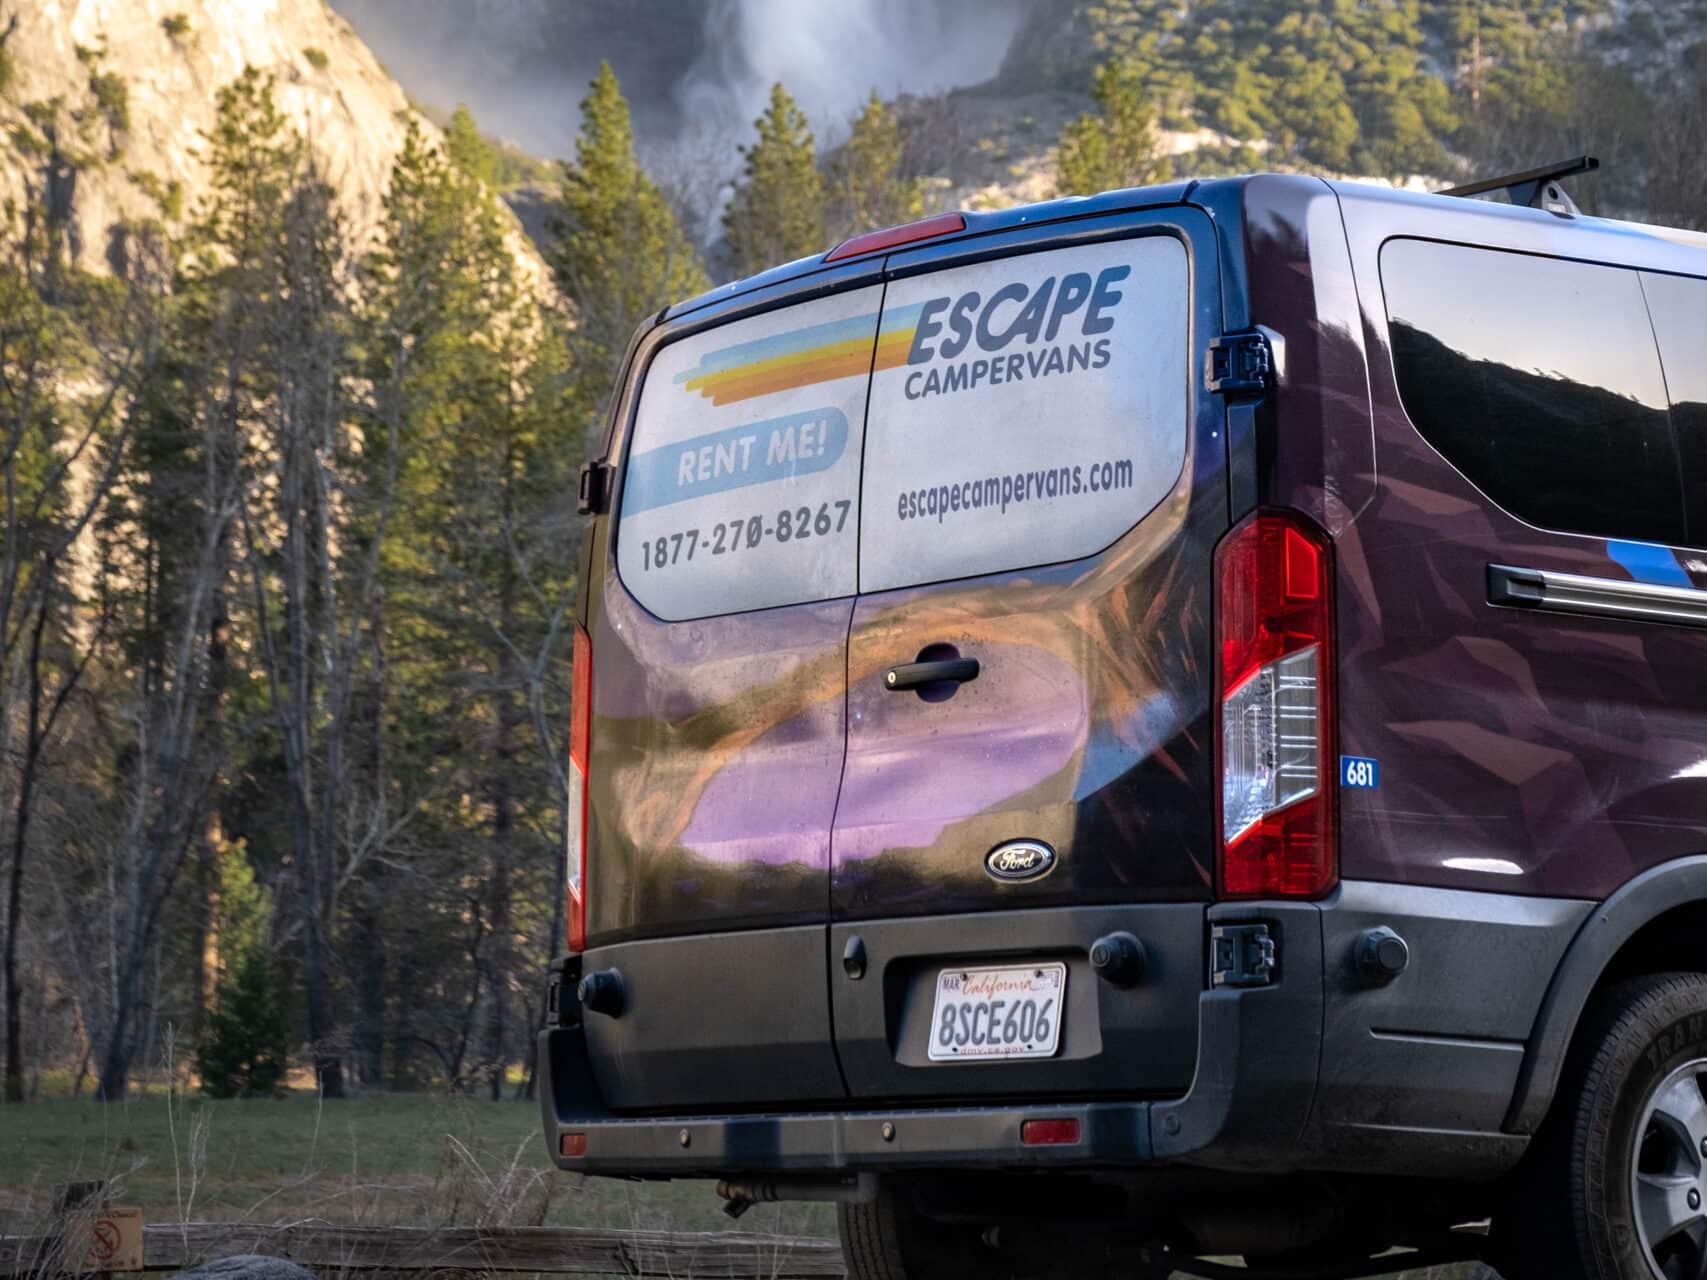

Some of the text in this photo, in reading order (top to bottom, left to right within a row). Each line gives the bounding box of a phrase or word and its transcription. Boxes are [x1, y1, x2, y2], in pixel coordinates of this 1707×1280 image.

[907, 265, 1131, 366] ESCAPE
[904, 339, 1112, 400] CAMPERVANS
[677, 420, 828, 487] RENT ME!
[897, 458, 1133, 523] escapecampervans.com
[642, 499, 851, 571] 1877-270-8267
[1347, 760, 1373, 787] 681
[1000, 849, 1034, 870] Ford
[962, 974, 1040, 999] California
[939, 998, 1053, 1047] 8SCE606
